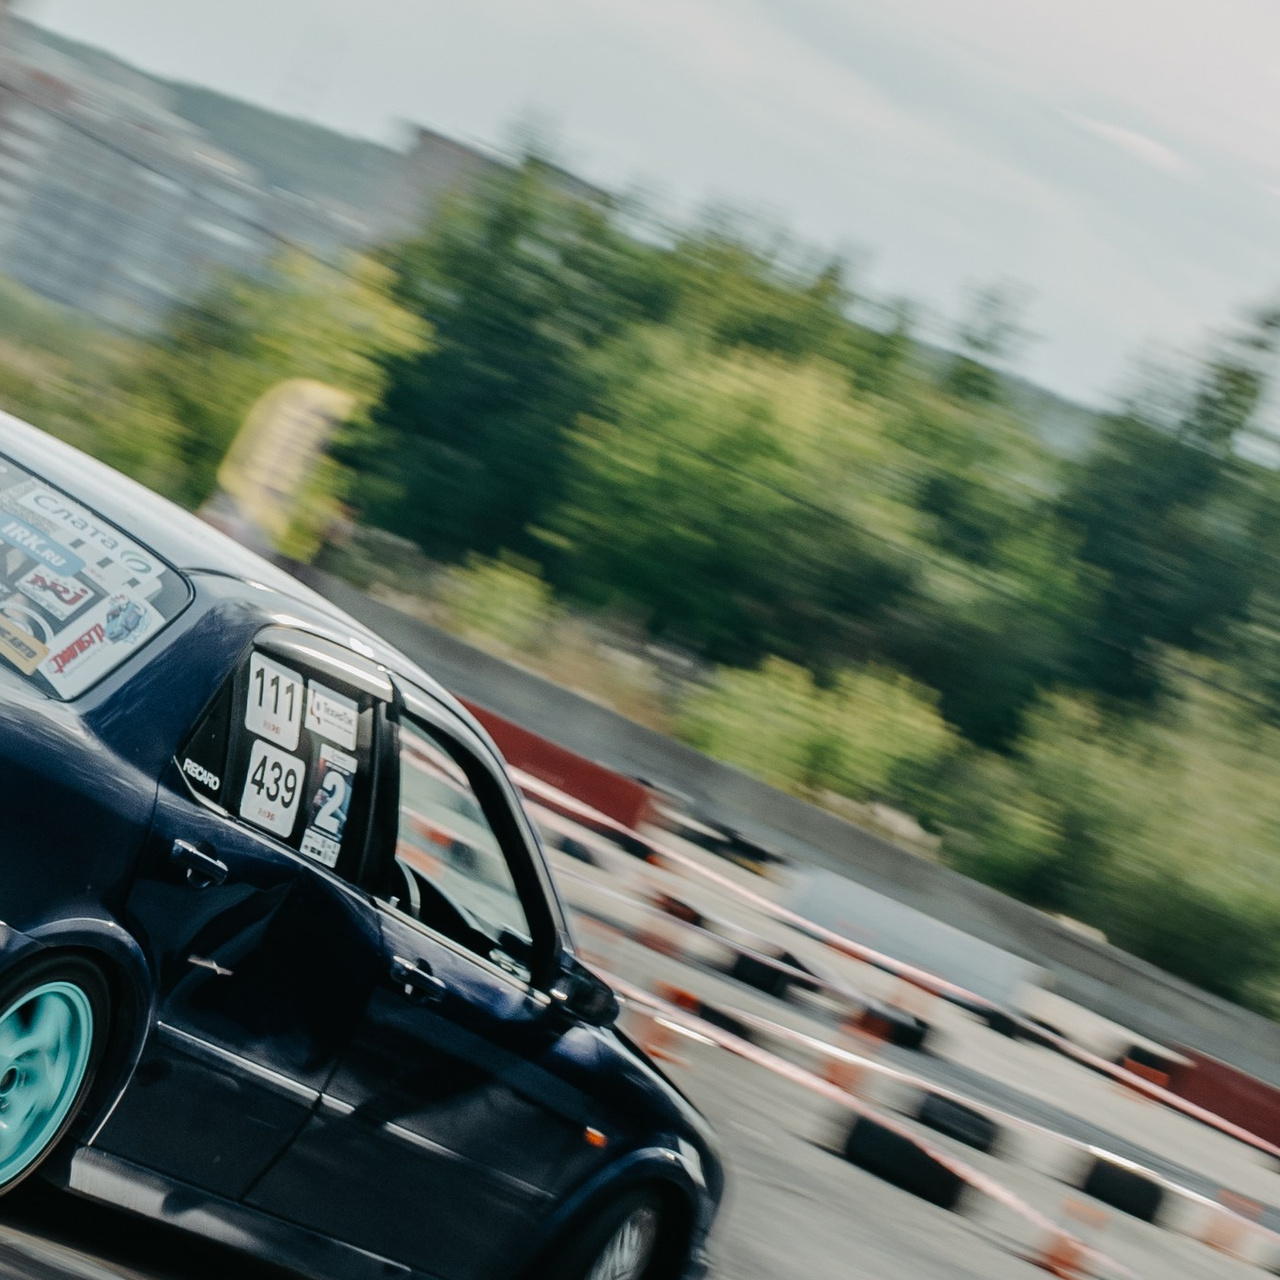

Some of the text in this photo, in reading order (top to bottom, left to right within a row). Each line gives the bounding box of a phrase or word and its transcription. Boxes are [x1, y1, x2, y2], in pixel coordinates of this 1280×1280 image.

[0, 521, 67, 567] IRK.RU
[32, 494, 120, 550] Слата
[254, 667, 295, 722] 111
[183, 758, 220, 791] RECARO
[250, 754, 298, 809] 439
[314, 770, 346, 834] 2
